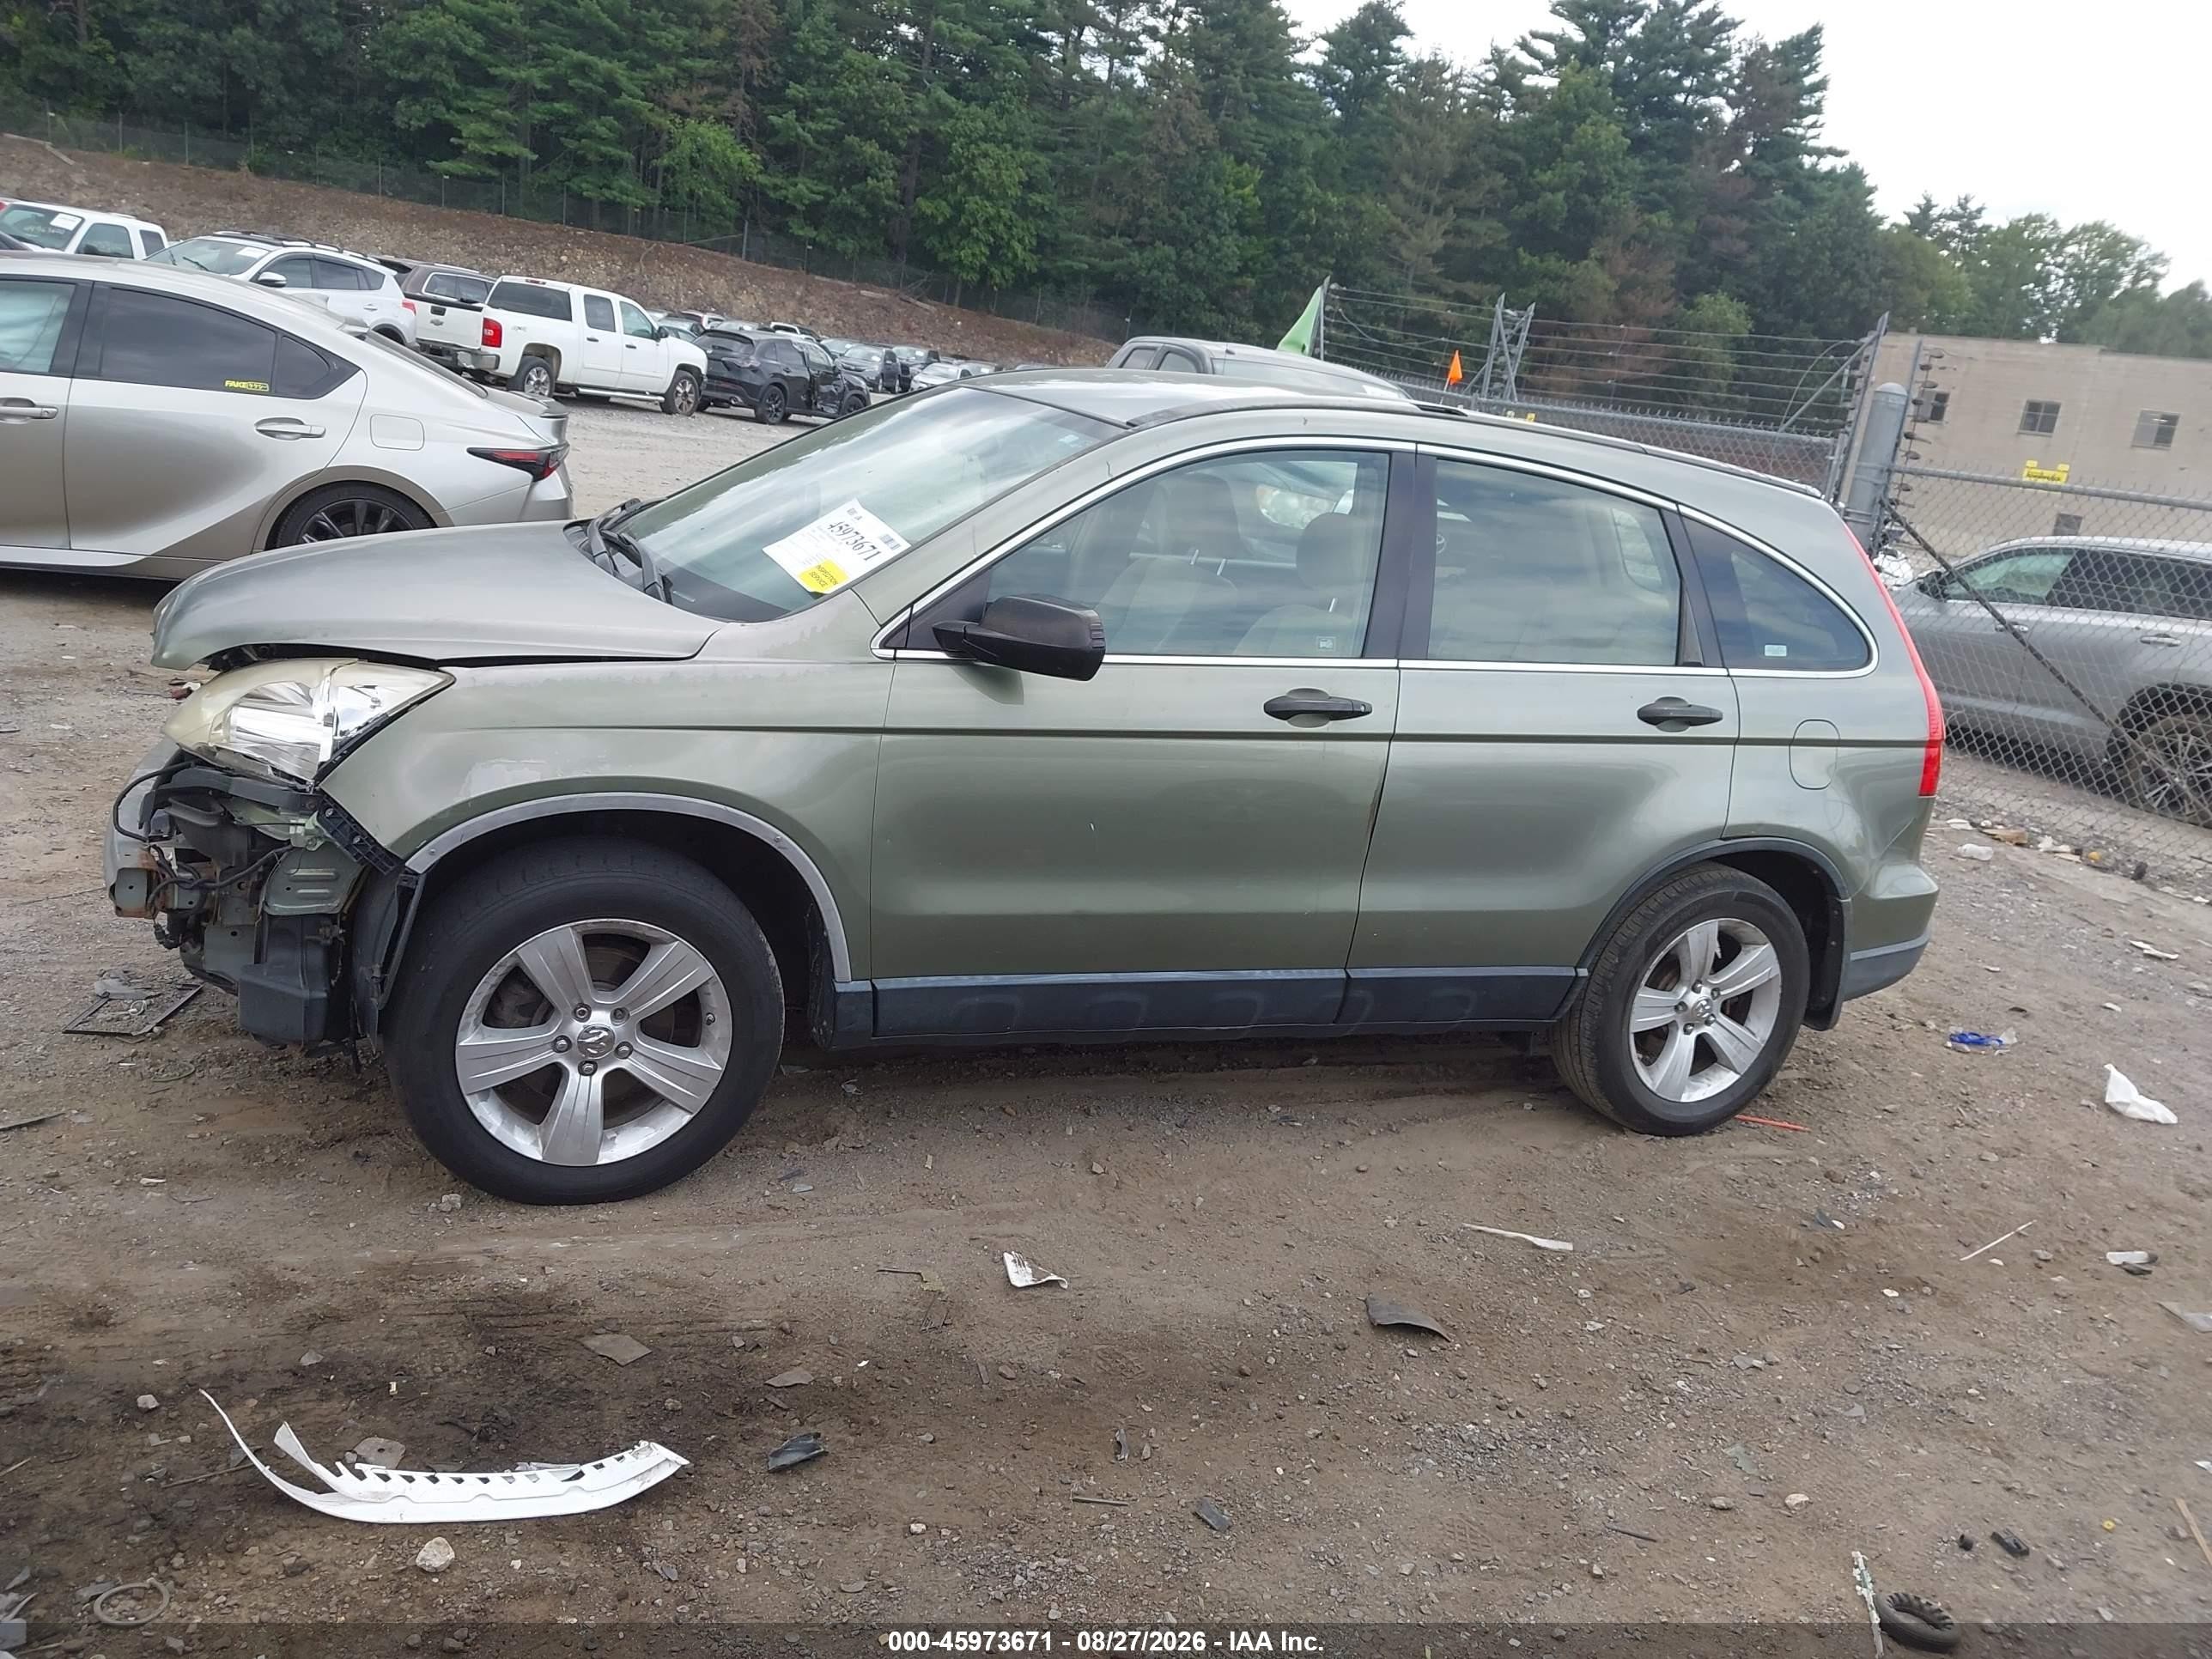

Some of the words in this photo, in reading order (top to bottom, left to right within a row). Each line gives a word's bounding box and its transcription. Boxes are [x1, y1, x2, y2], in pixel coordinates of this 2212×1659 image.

[225, 380, 247, 389] FAKE
[827, 520, 883, 562] 45973671
[809, 571, 829, 588] SERVICE
[816, 564, 839, 586] INSPECTION
